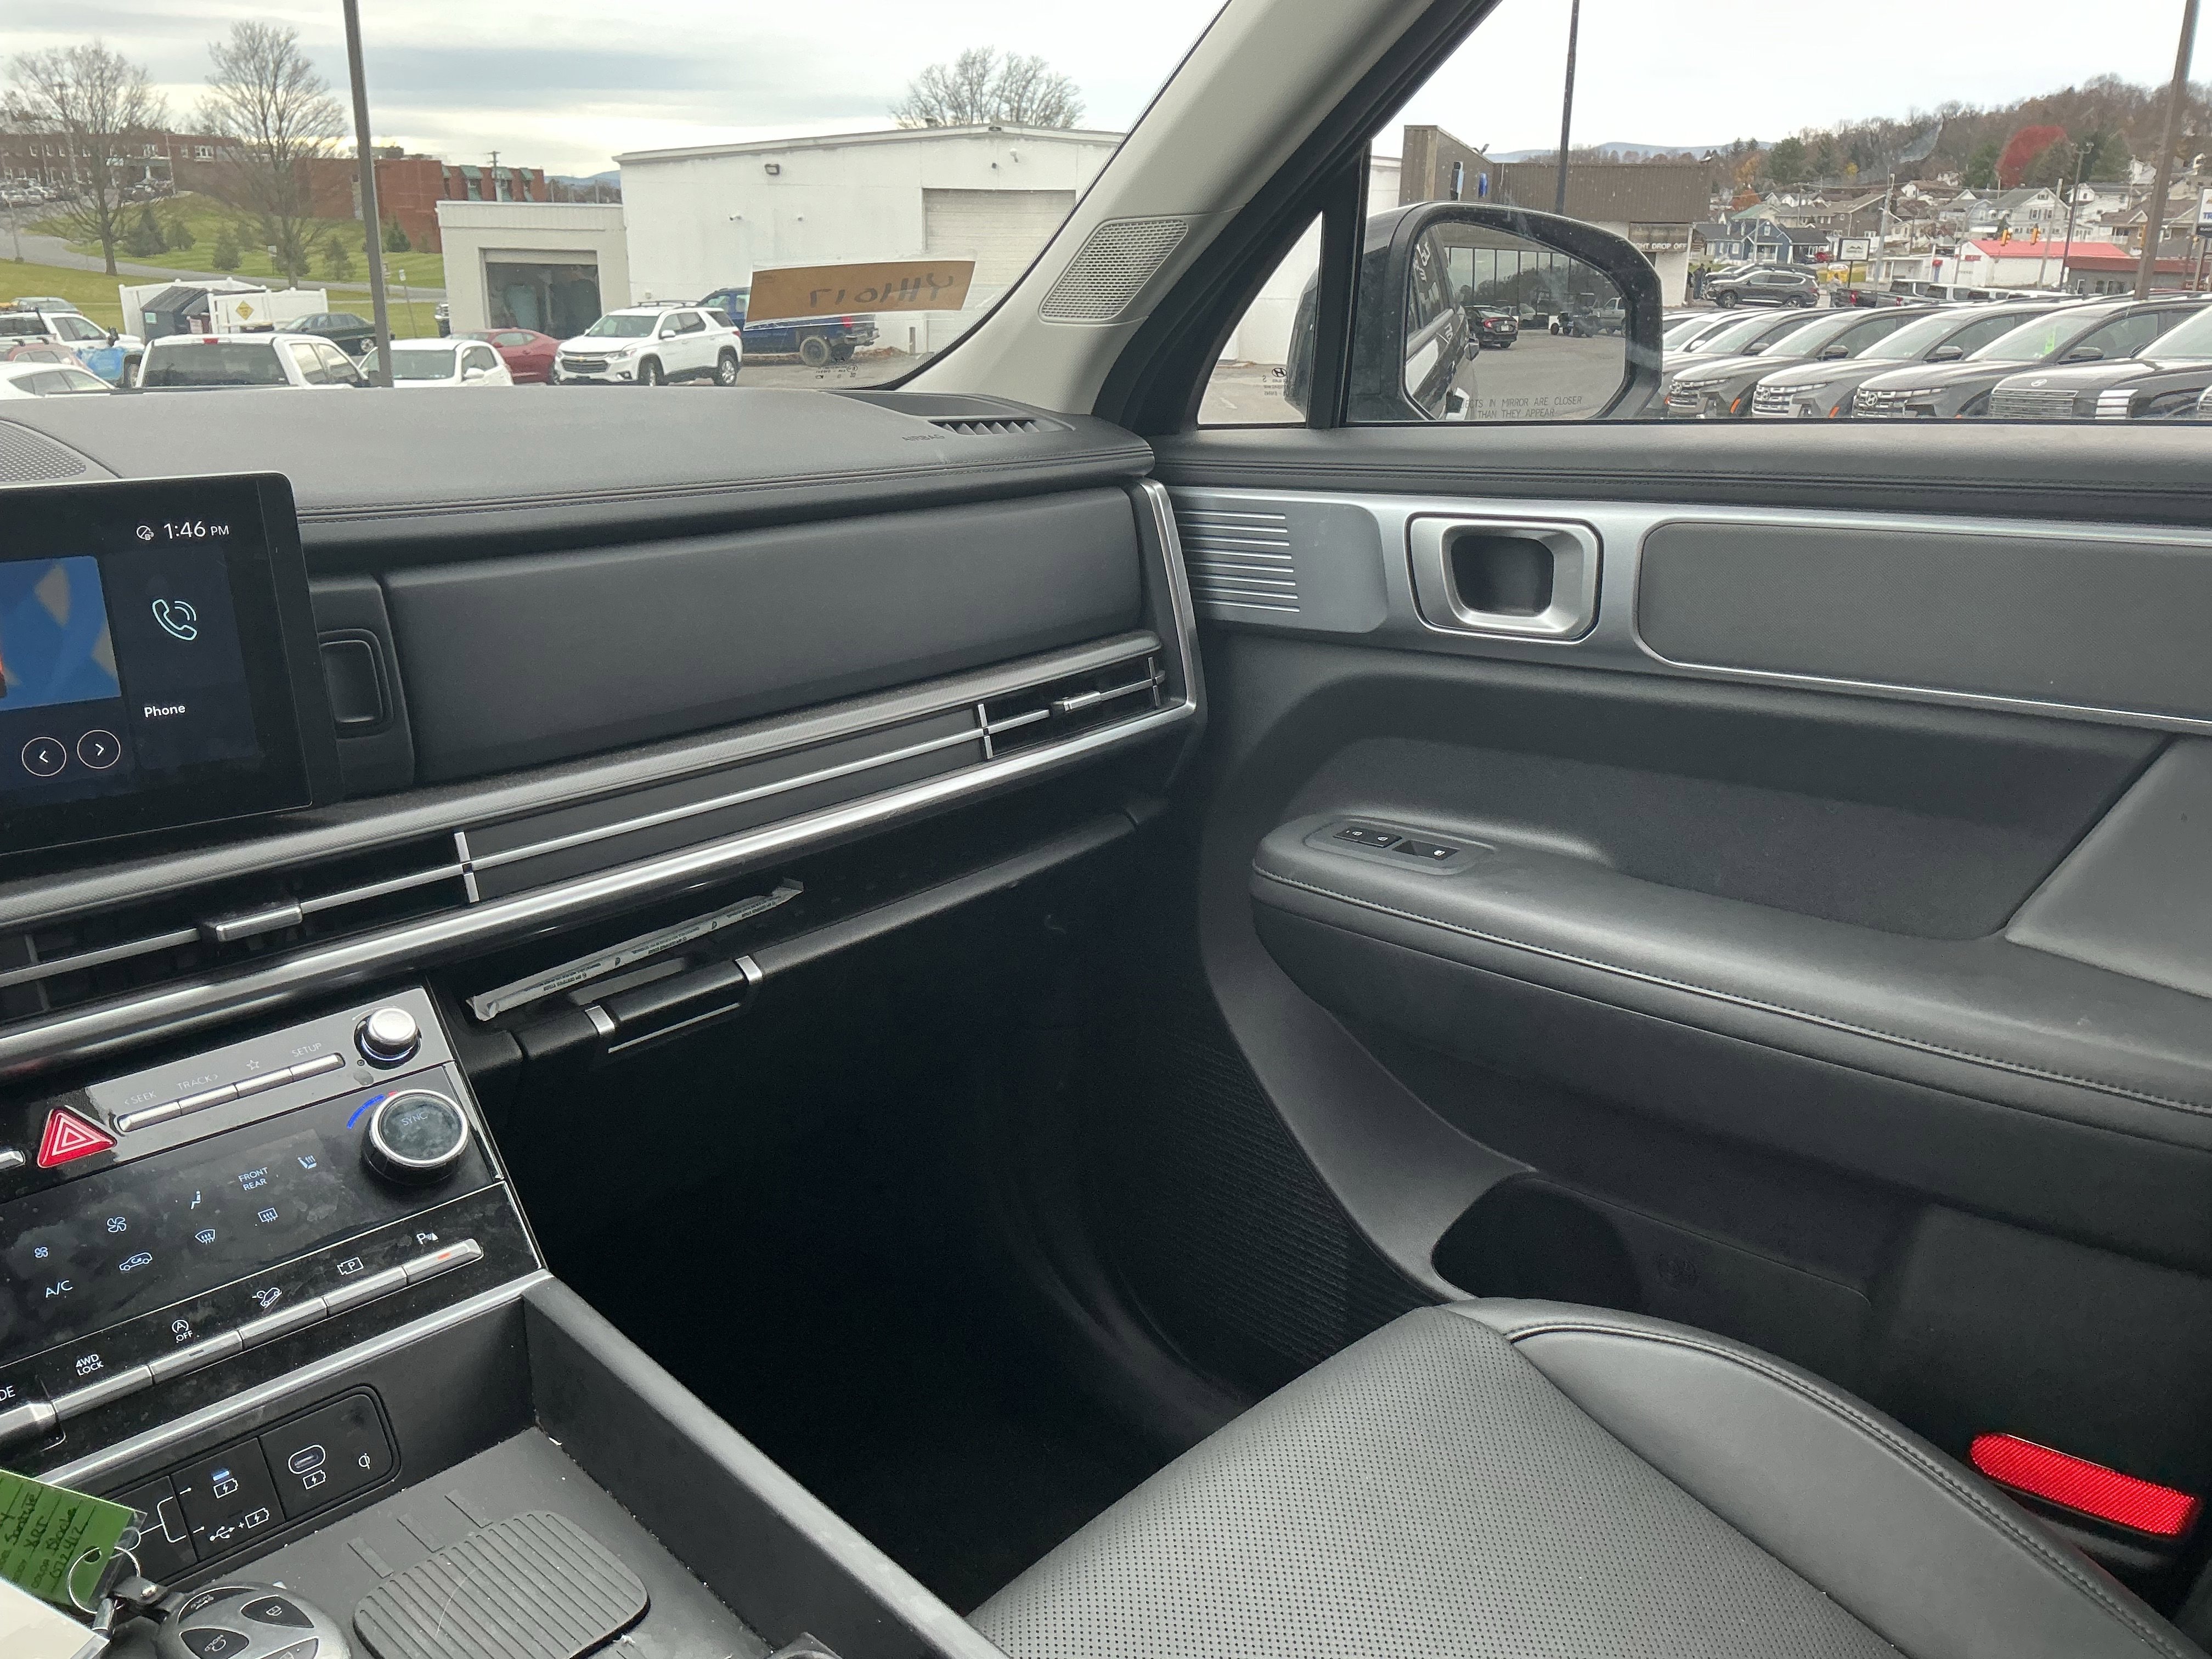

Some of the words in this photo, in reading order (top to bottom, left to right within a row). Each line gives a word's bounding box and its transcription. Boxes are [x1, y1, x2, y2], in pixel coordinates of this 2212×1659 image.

[1489, 399, 1496, 407] IN
[1502, 398, 1529, 407] MIRROR
[1534, 397, 1548, 406] ARE
[1554, 396, 1583, 405] CLOSER
[1478, 410, 1497, 419] THAN
[1502, 409, 1521, 418] THEY
[1525, 407, 1554, 417] APPEAR
[164, 521, 206, 539] 1:46
[210, 524, 230, 536] PM
[144, 703, 186, 718] Phone
[291, 1042, 322, 1057] SETUP
[130, 1090, 157, 1104] SEEK
[176, 1075, 212, 1091] TRACK
[400, 1111, 428, 1126] SYNC
[238, 1167, 268, 1182] FRONT
[242, 1178, 268, 1191] REAR
[45, 1280, 73, 1298] A/C
[176, 1330, 193, 1342] OFF
[75, 1353, 100, 1368] 4WD
[77, 1360, 104, 1376] LOCK
[204, 1634, 224, 1651] HOLD
